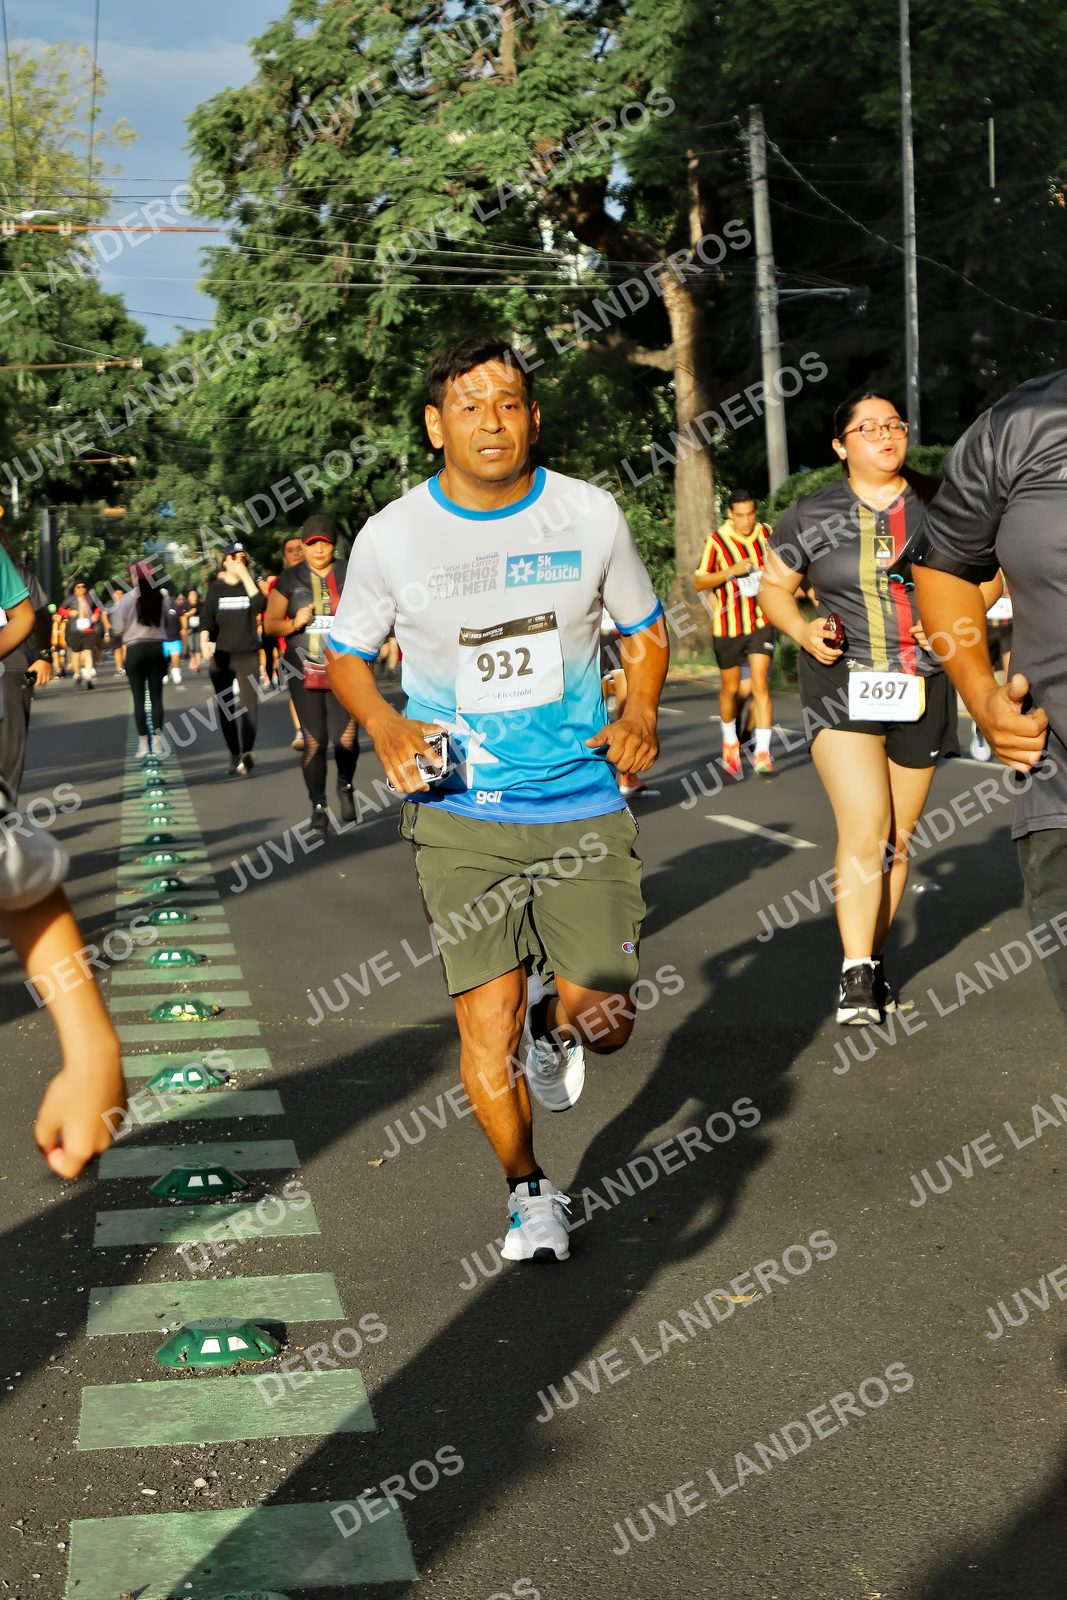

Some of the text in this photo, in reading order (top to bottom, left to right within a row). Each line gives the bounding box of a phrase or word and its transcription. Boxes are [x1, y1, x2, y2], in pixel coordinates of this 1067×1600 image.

[536, 565, 579, 582] POLICÍA
[463, 579, 497, 596] META
[477, 647, 533, 682] 932
[859, 681, 908, 699] 2697
